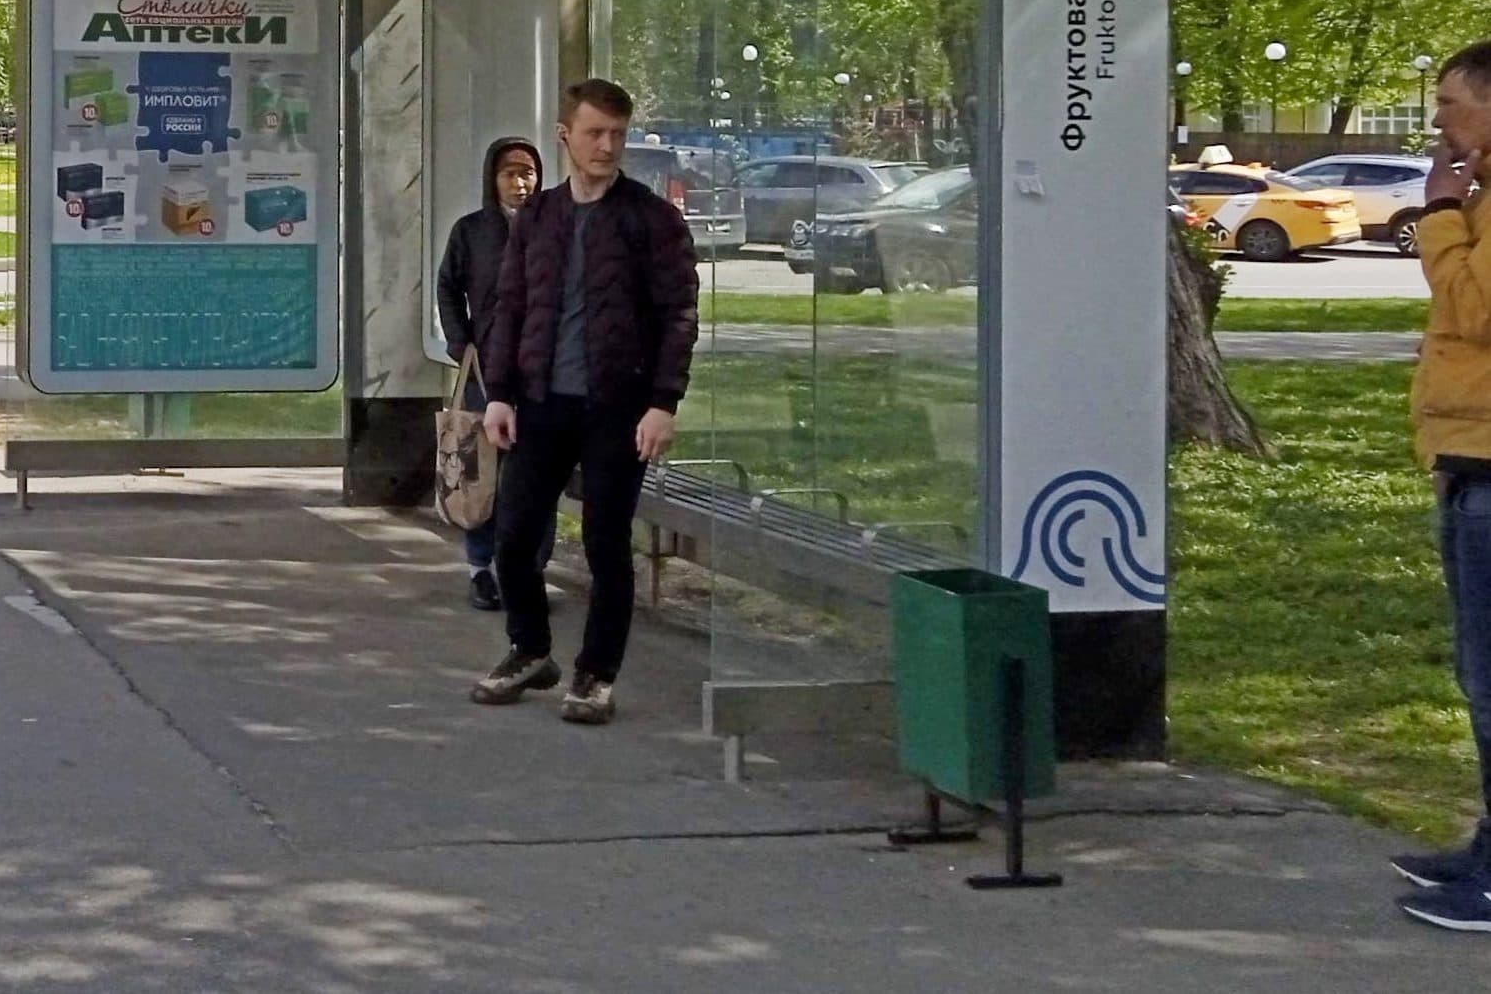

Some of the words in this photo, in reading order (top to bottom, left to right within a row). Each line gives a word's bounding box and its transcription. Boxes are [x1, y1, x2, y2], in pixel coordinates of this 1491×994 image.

[84, 107, 95, 119] 10
[68, 204, 79, 214] 10
[201, 222, 211, 232] 10
